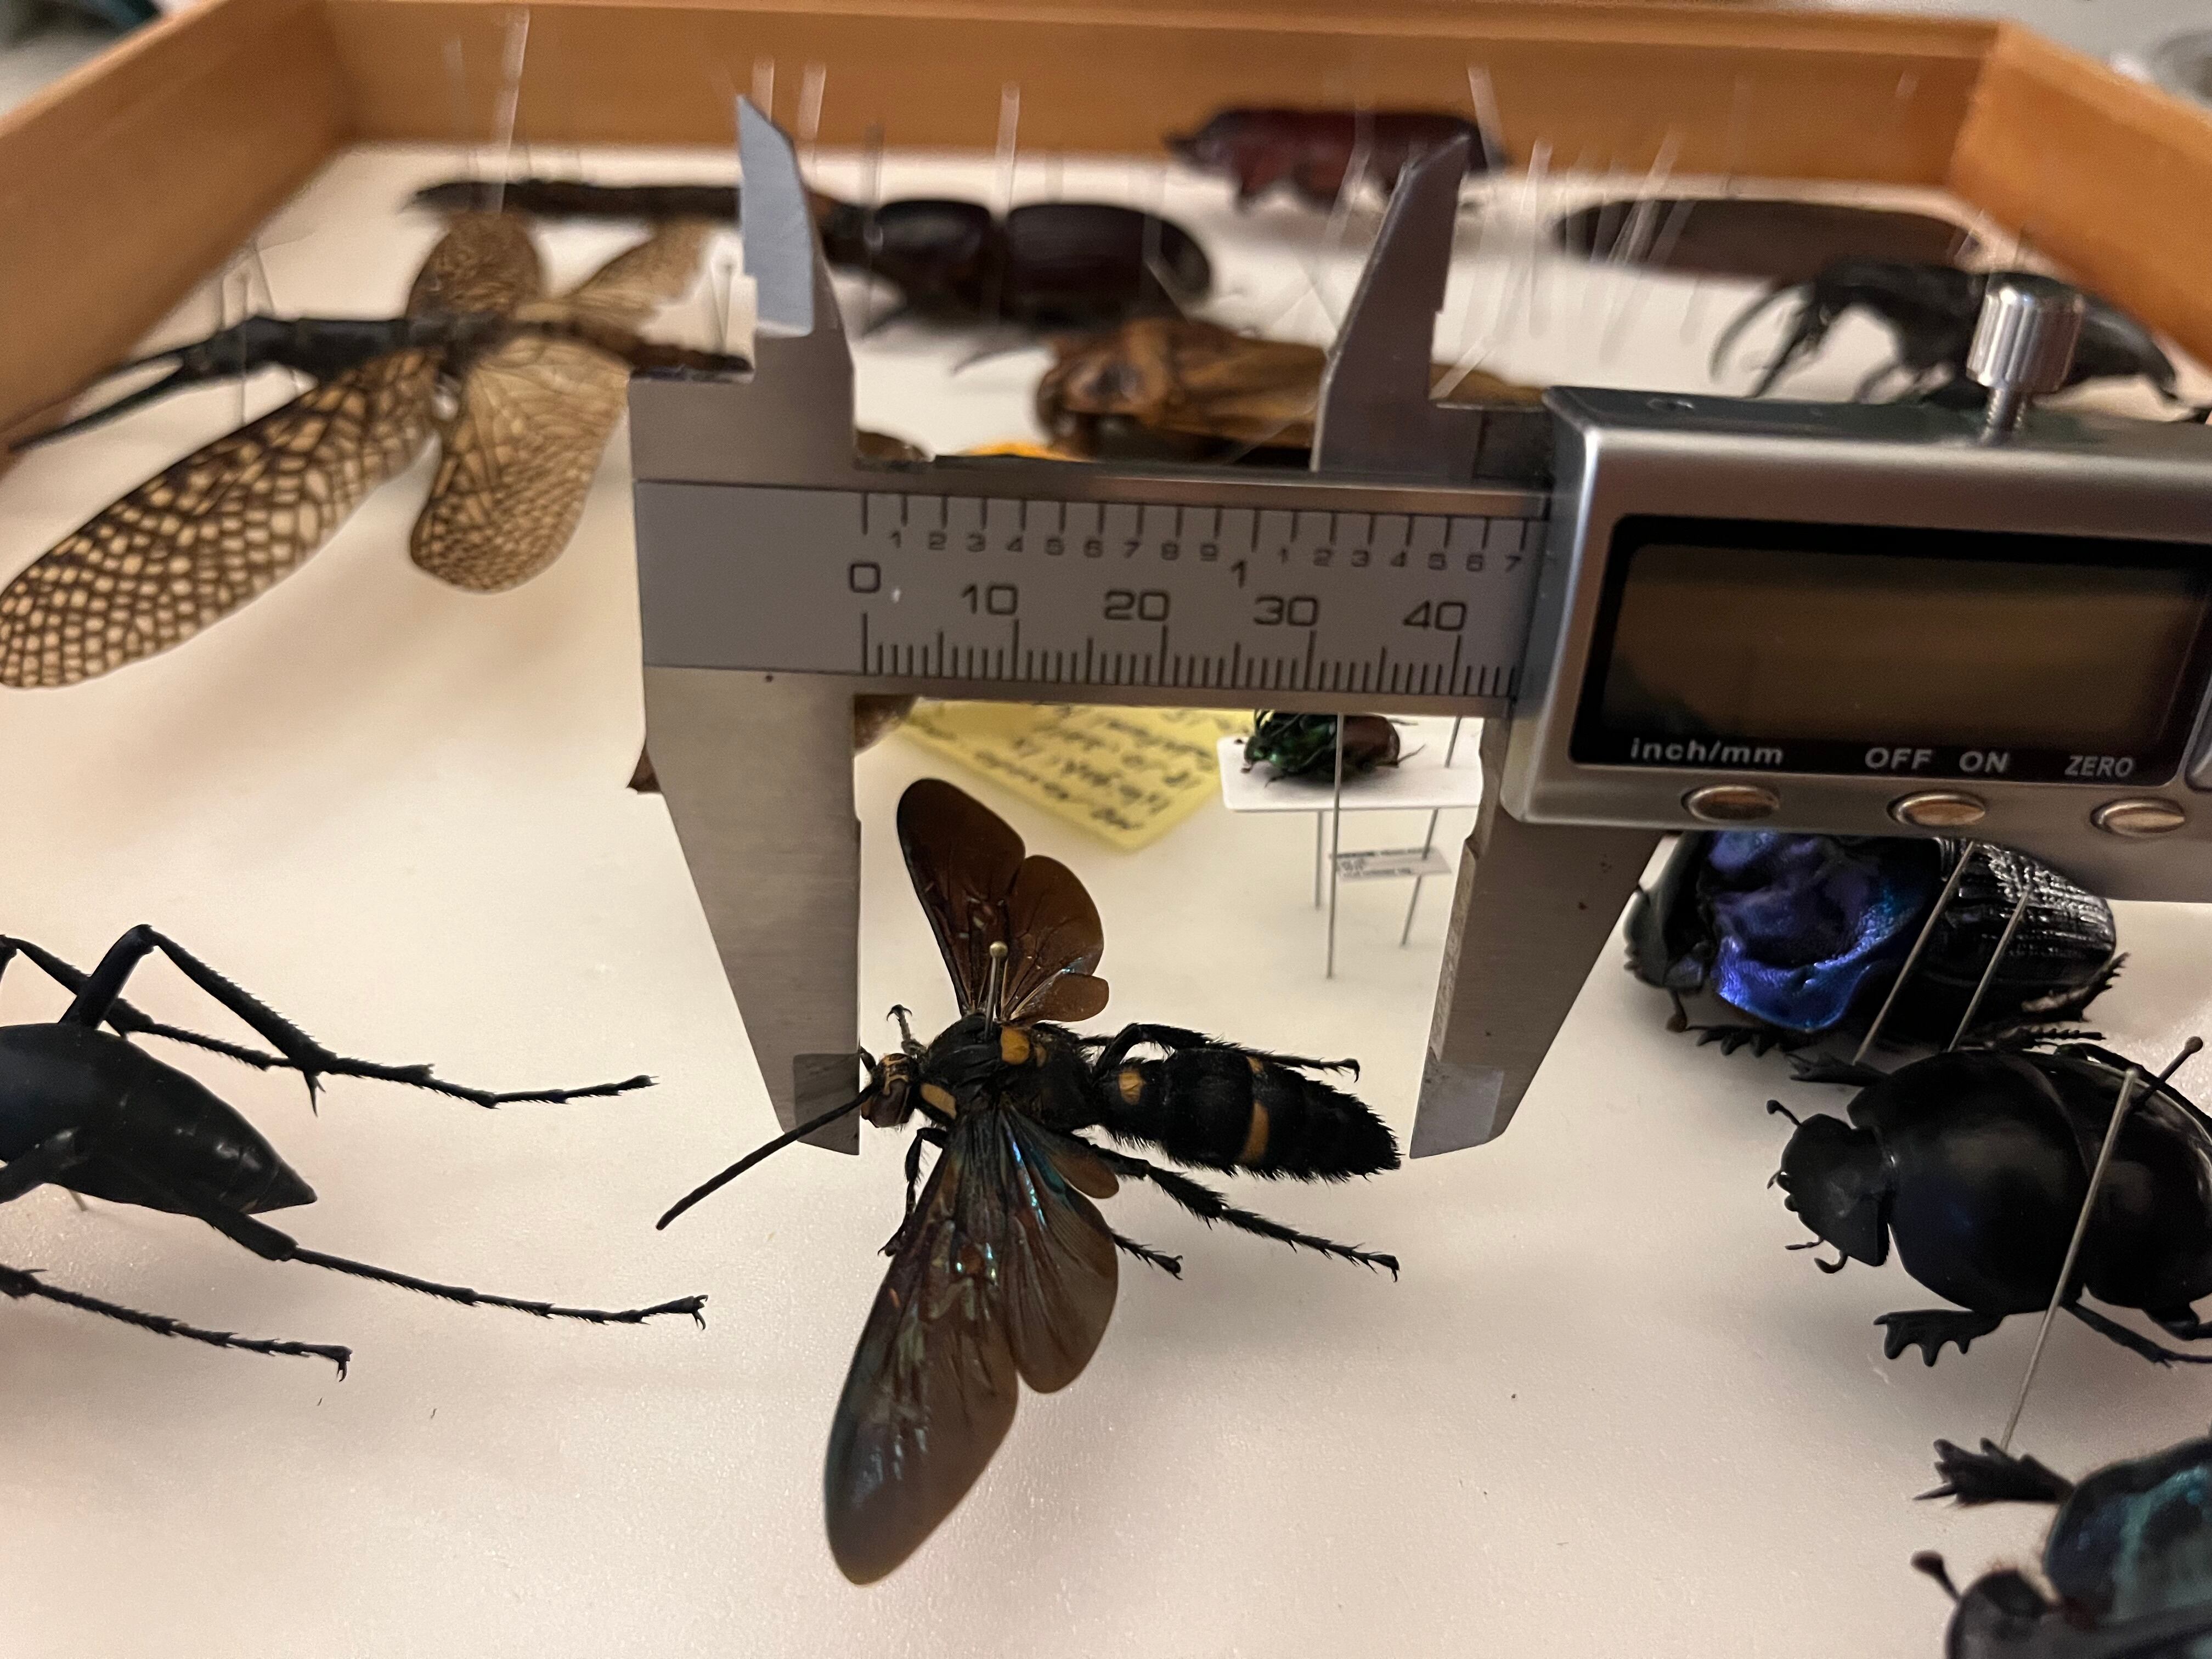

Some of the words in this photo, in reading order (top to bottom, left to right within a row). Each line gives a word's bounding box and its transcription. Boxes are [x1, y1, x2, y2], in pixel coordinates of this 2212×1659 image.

[890, 531, 902, 548] 1
[929, 532, 947, 549] 2
[967, 533, 986, 551] 3
[1006, 535, 1024, 552] 4
[1084, 538, 1103, 558] 6
[1124, 541, 1141, 557] 7
[1160, 541, 1180, 560] 8
[1313, 549, 1331, 566] 2
[1351, 550, 1370, 567] 3
[1390, 552, 1407, 567] 4
[1466, 554, 1483, 572] 6
[1505, 556, 1522, 571] 7
[1231, 560, 1246, 588] 1
[848, 561, 881, 593] 0
[961, 584, 1019, 615] 10
[1103, 590, 1170, 622] 20
[1252, 595, 1319, 627] 30
[1402, 601, 1467, 632] 40
[1630, 737, 1784, 765] inch/mm
[1865, 747, 1932, 770] OFF
[1959, 751, 2010, 773] ON
[2064, 755, 2136, 778] ZERO
